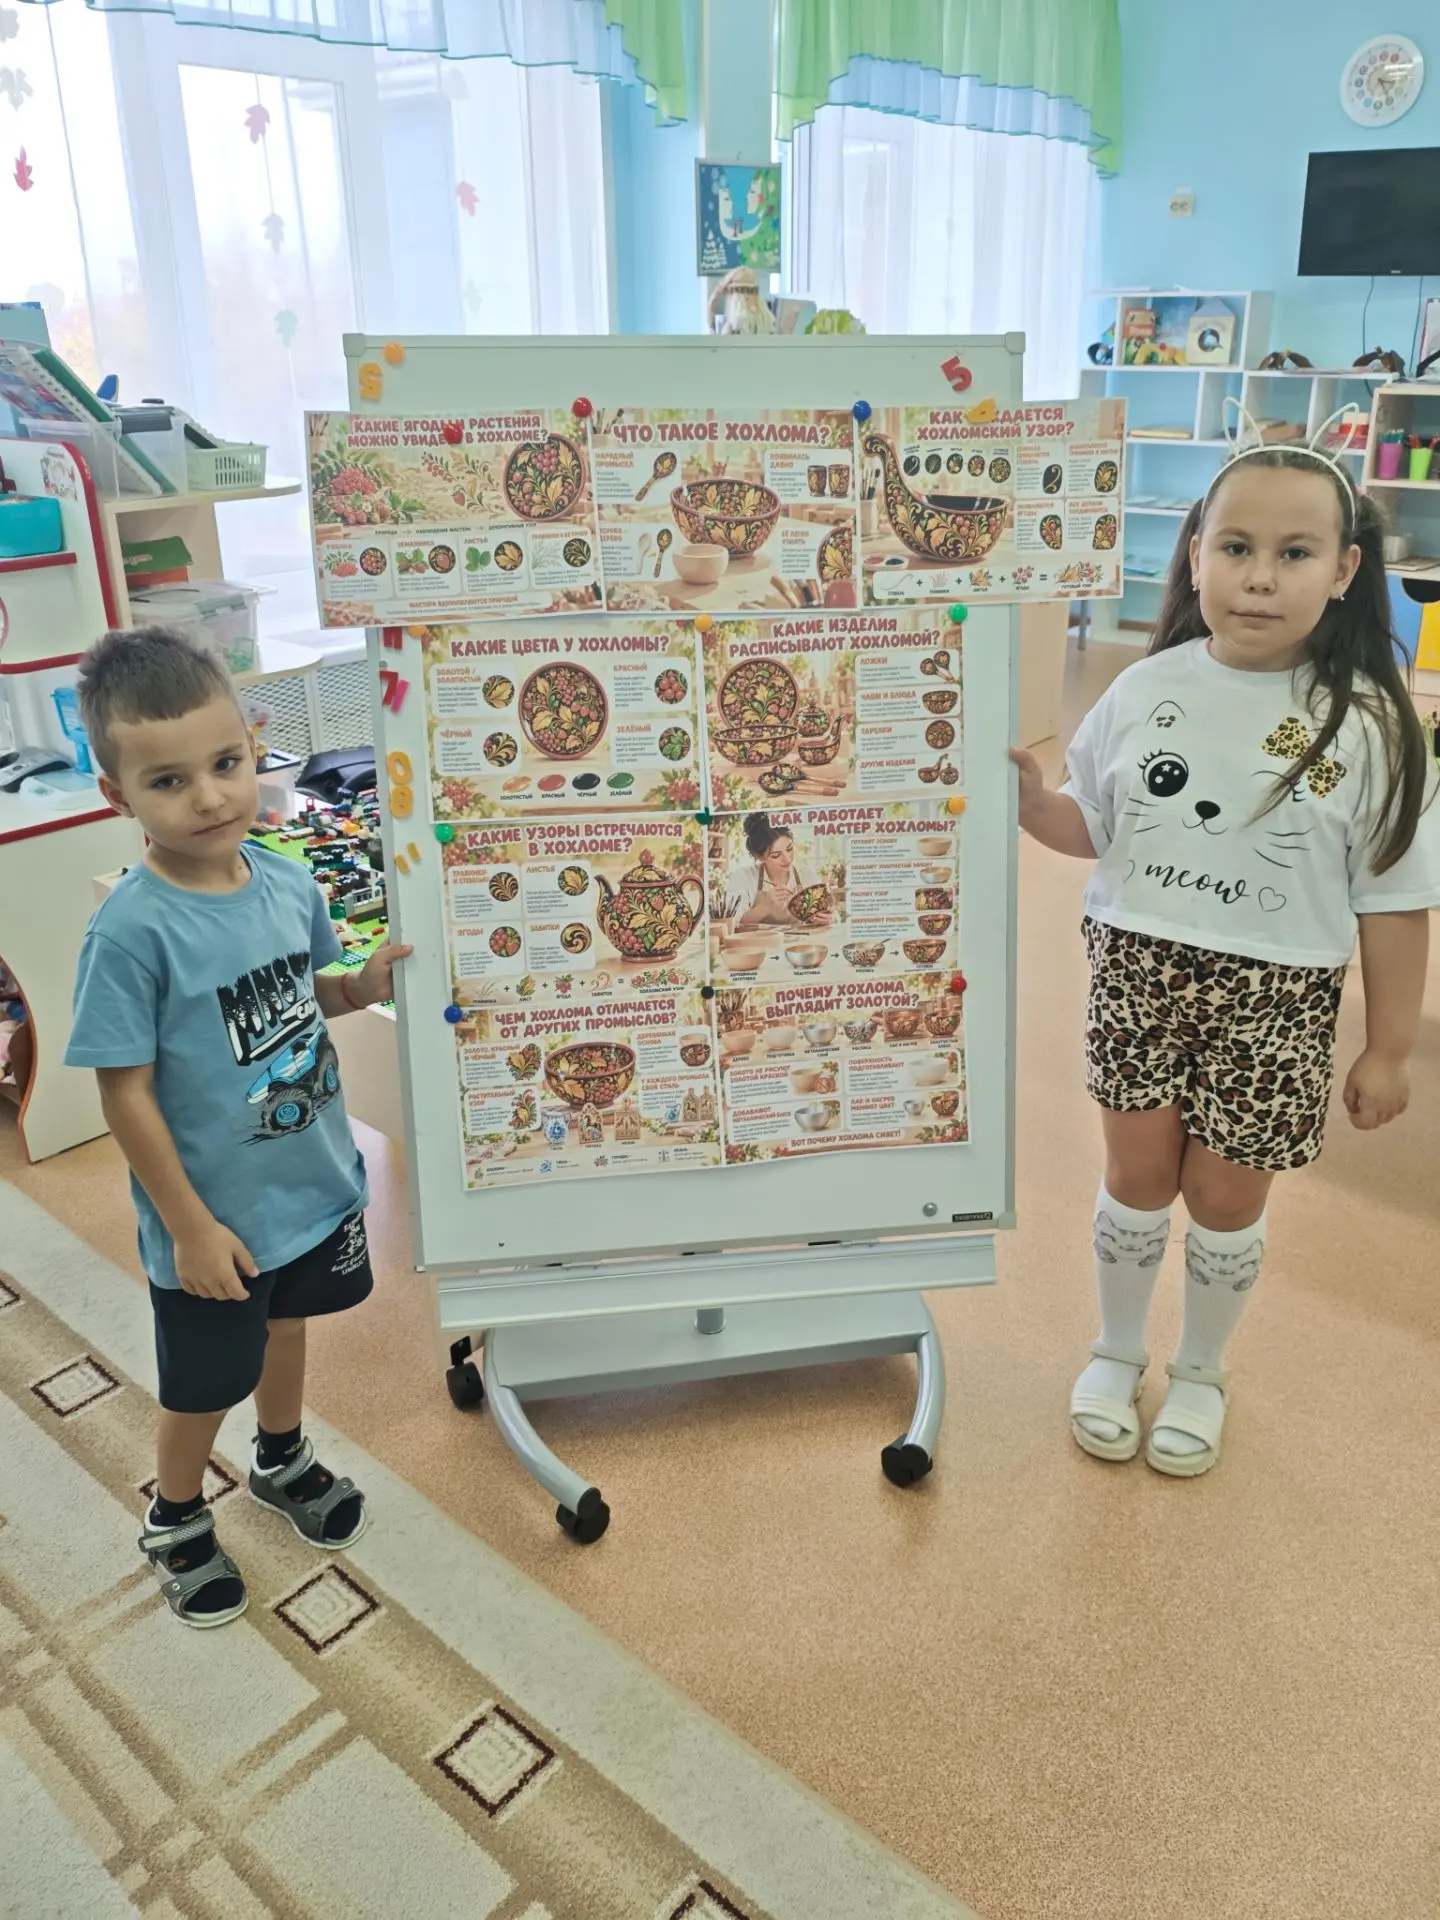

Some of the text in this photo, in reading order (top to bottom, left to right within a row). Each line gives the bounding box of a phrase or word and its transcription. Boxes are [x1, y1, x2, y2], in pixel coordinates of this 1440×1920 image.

[354, 420, 399, 433] КАКИЕ
[469, 416, 540, 429] РАСТЕНИЯ
[930, 407, 1063, 425] КАК ДАЕТСЯ
[347, 428, 548, 448] МОЖНО УВИДЕ В ХОХЛОМЕ?
[614, 422, 830, 444] ЧТО ТАКОЕ ХОХЛОМА?
[917, 421, 1075, 440] ХОХЛОМСКИЙ УЗОР?
[773, 618, 897, 638] КАКИЕ ИЗДЕЛИЯ
[451, 635, 670, 658] КАКИЕ ЦВЕТА У ХОХЛОМЫ?
[729, 630, 940, 657] РАСПИСЫВАЮТ ХОХЛОМОЙ?
[771, 807, 884, 827] КАК РАБОТАЕТ
[467, 823, 682, 848] КАКИЕ УЗОРЫ ВСТРЕЧАЮТСЯ
[814, 820, 956, 836] МАСТЕР ХОХЛОМЫ?
[529, 838, 633, 856] В ХОХЛОМЕ?
[1145, 862, 1250, 904] meow
[776, 980, 904, 1003] ПОЧЕМУ ХОХЛОМА
[495, 999, 676, 1027] ЧЕМ ХОХЛОМА ОТЛИЧАЕТСЯ
[766, 994, 919, 1019] ВЫГЛЯДИТ ЗОЛОТОЙ?
[500, 1012, 677, 1039] ОТ ДРУГИХ ПРОМЫСЛОВ?
[791, 1129, 901, 1147] ВОТ ПОЧЕМУ ХОХЛОМА СИЯЕТ!
